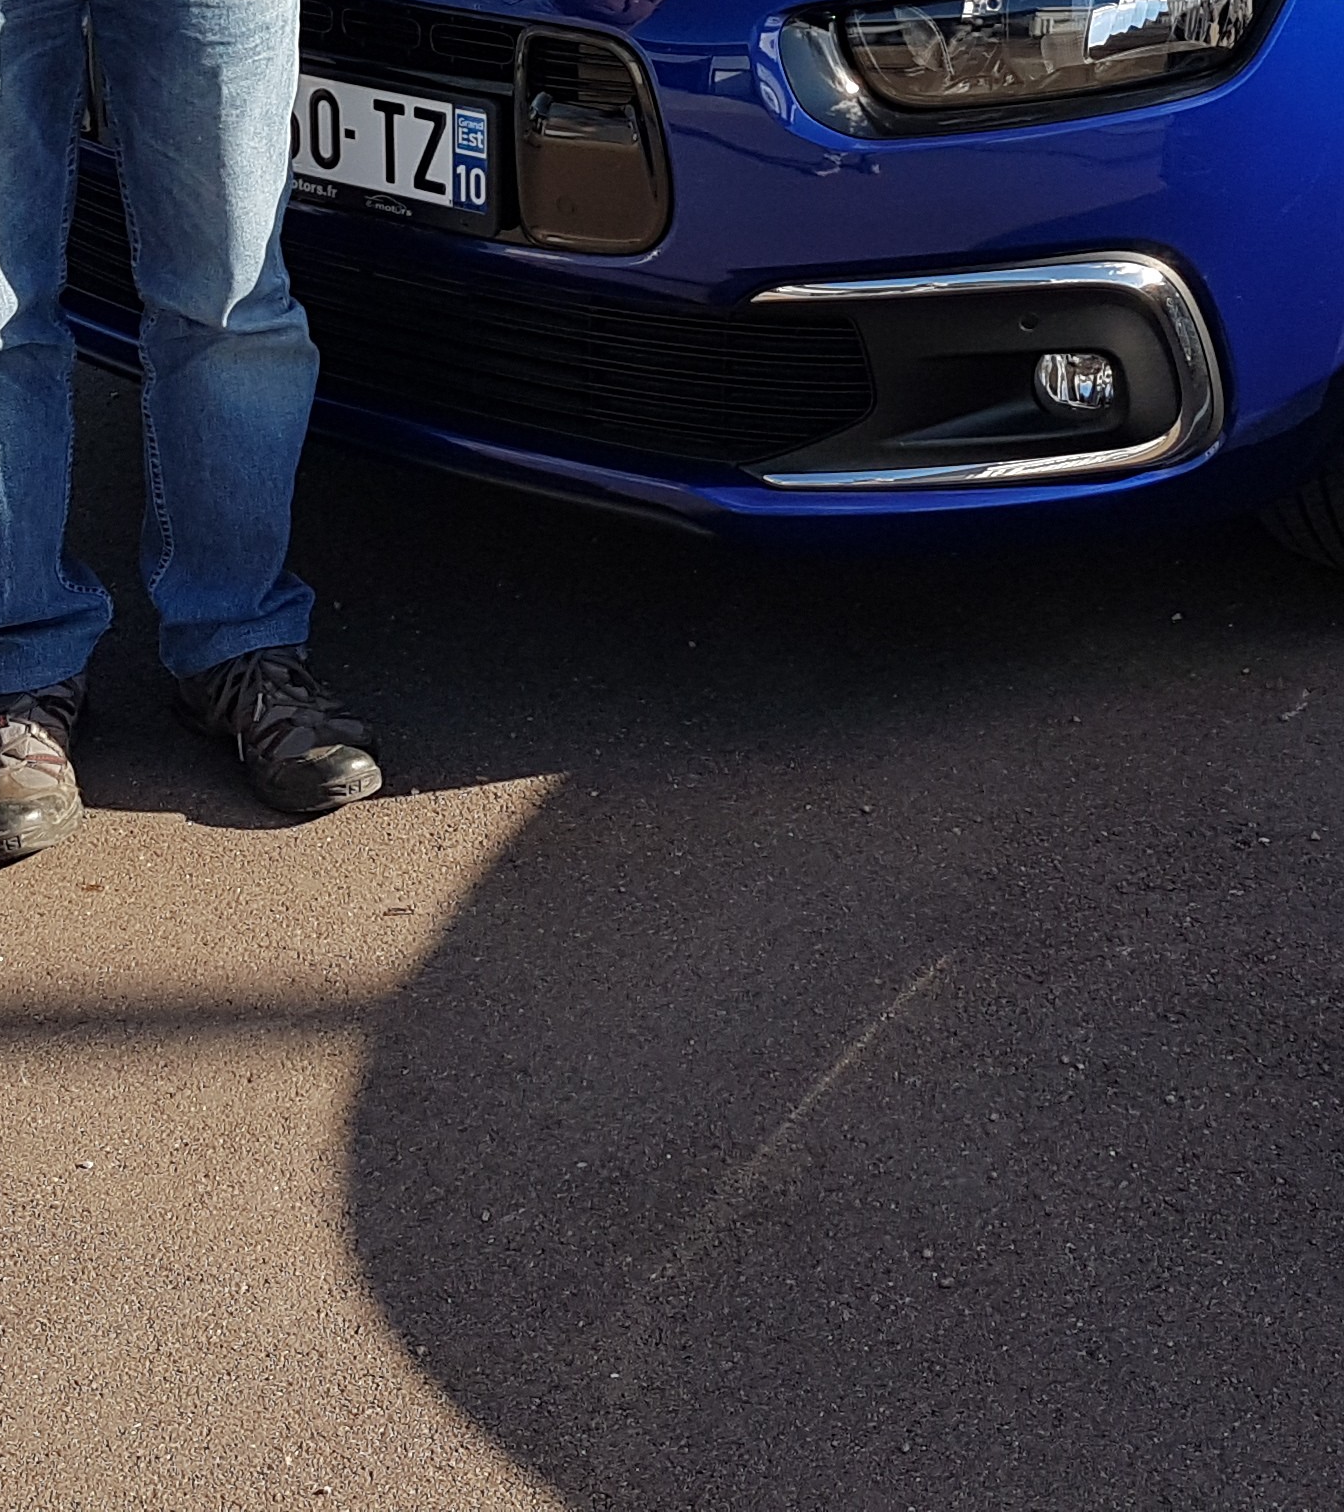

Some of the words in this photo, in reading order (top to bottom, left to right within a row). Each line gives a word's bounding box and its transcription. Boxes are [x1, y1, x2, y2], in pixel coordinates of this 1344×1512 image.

[458, 117, 484, 130] Grand
[291, 88, 447, 195] 0-TZ
[458, 126, 484, 149] Est
[291, 178, 338, 198] otors.fr
[456, 164, 486, 205] 10
